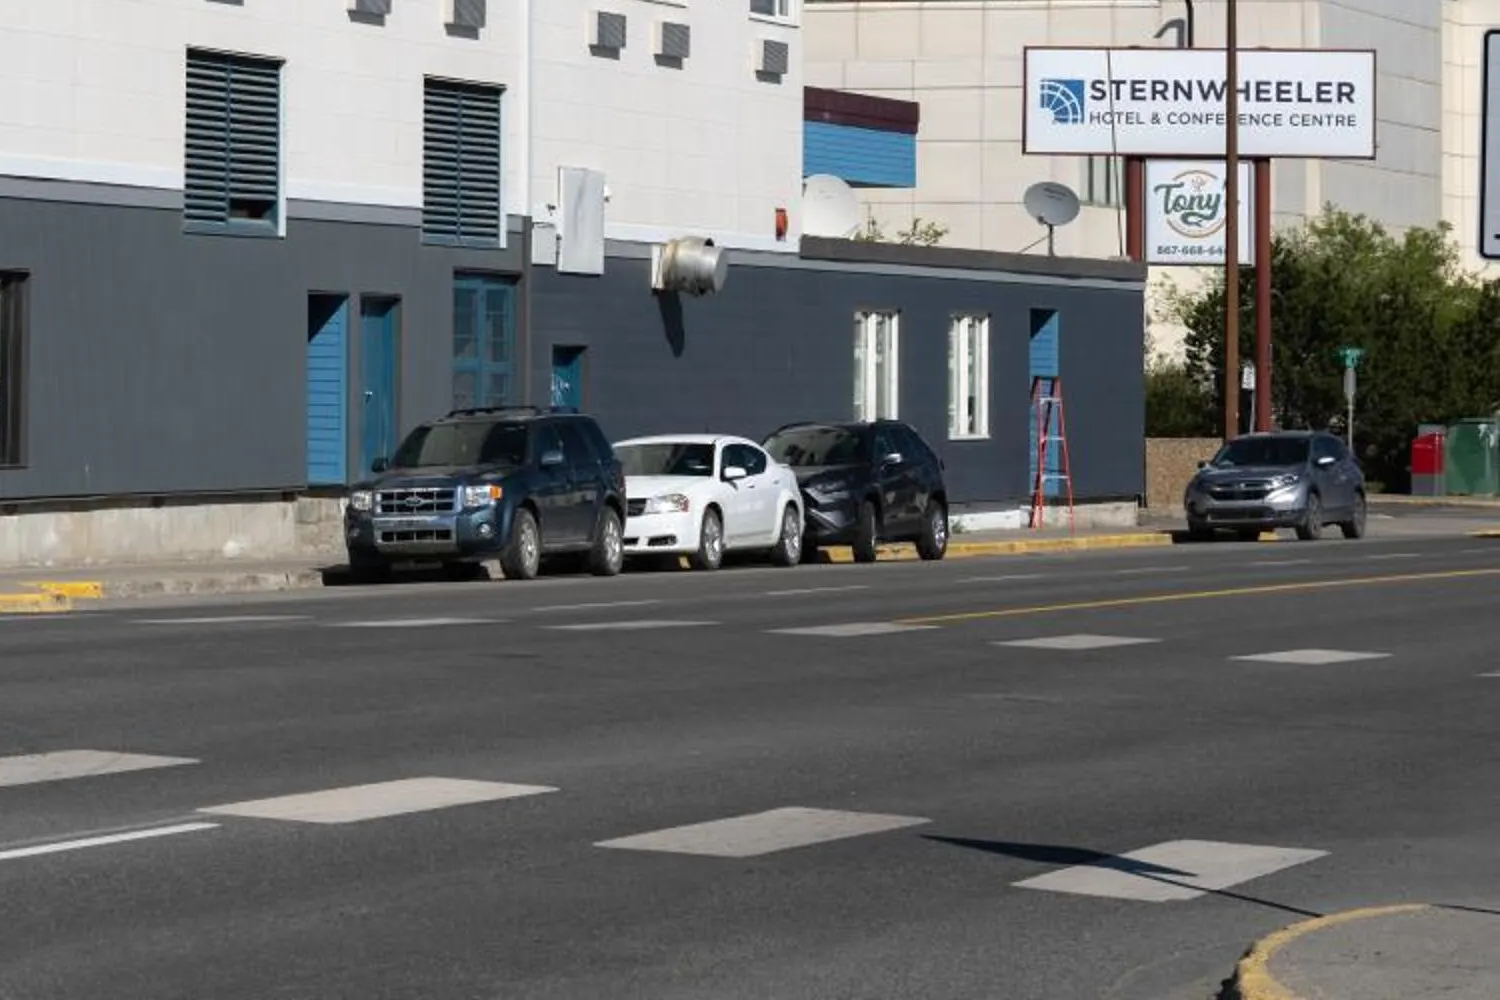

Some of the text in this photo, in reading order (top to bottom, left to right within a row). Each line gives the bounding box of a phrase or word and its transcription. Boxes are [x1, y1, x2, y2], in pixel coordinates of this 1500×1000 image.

[1090, 79, 1356, 103] STERNWHEELER
[1089, 112, 1357, 127] HOTEL & CONFEENCE CENTRE
